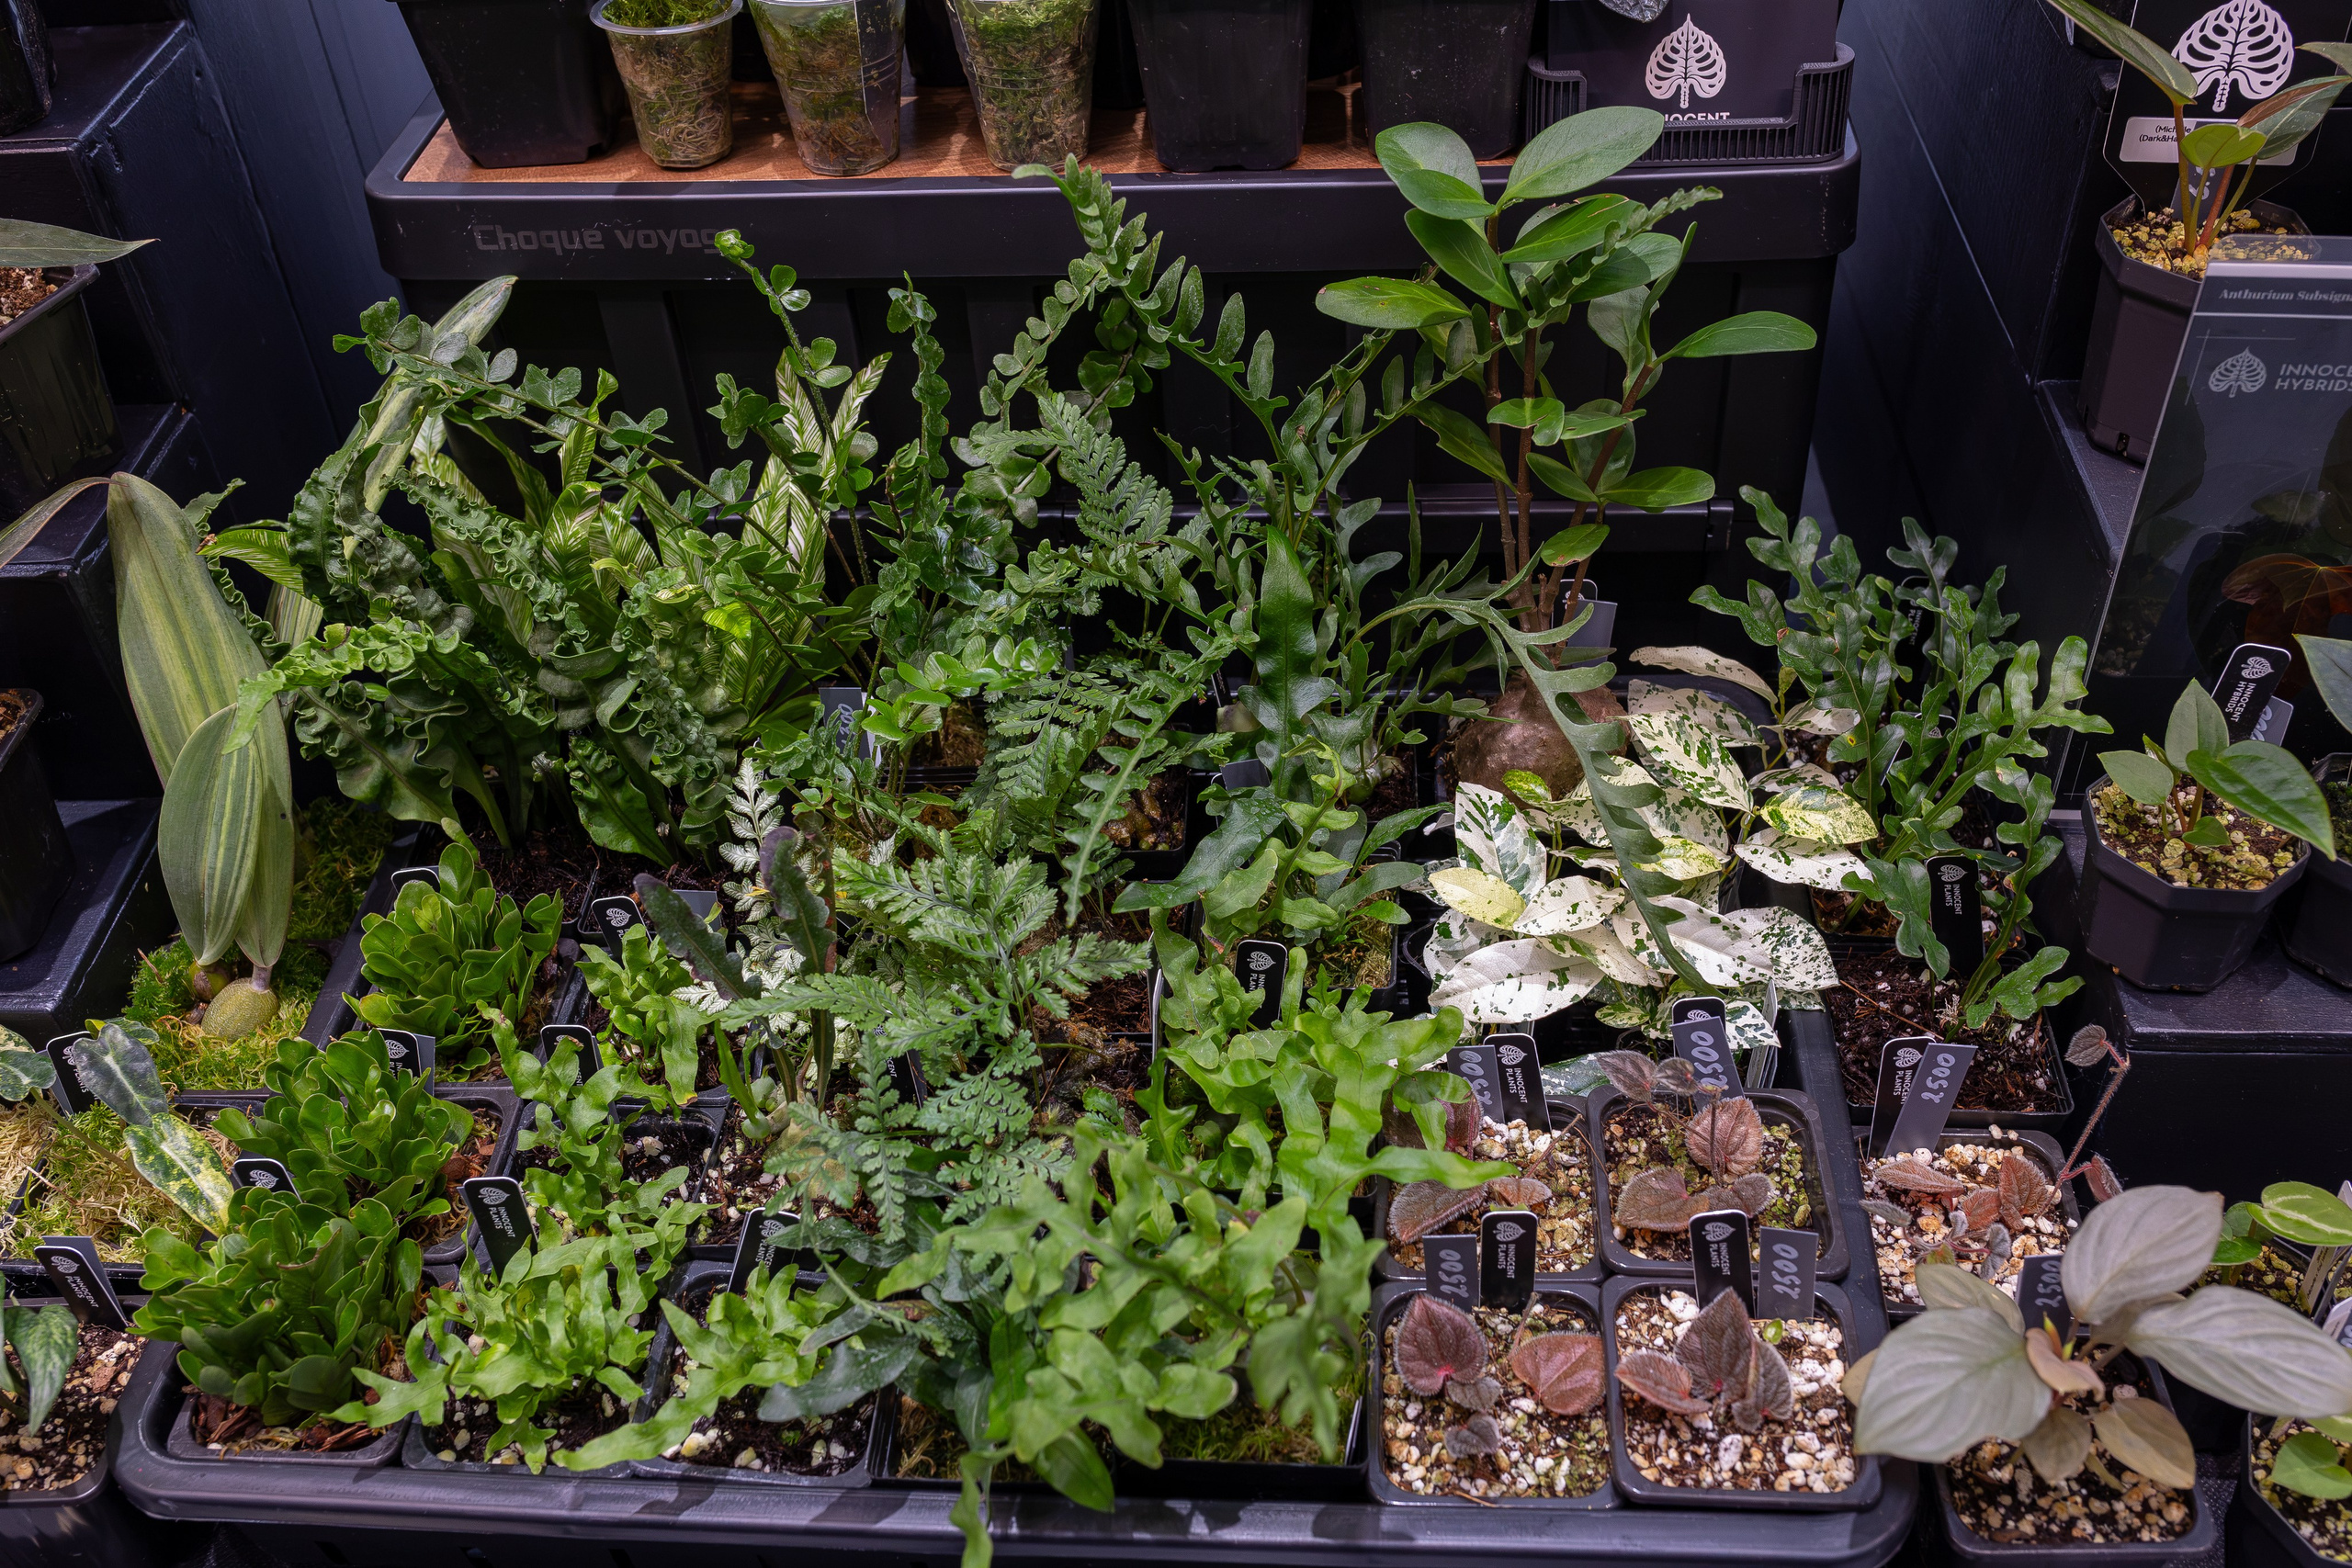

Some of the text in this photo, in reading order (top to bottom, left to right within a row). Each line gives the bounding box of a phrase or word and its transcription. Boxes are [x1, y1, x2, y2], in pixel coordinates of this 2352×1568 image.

[2139, 134, 2177, 142] (Dark&Ha
[473, 225, 720, 255] Choque voyag
[2219, 288, 2294, 300] Anthurium
[2224, 681, 2246, 713] HYBRIDS
[2230, 682, 2257, 723] INNOCENT
[1944, 884, 1953, 907] PLANTS
[1952, 884, 1962, 915] INNOCENT
[1690, 1031, 1729, 1090] 2500
[1506, 1067, 1517, 1094] PLANTS
[1514, 1067, 1528, 1103] INNOCENT
[1893, 1070, 1905, 1096] PLANTS
[1921, 1053, 1956, 1103] 2500
[488, 1206, 503, 1230] PLANTS
[497, 1206, 515, 1238] INNOCENT
[1498, 1244, 1507, 1269] PLANTS
[1506, 1244, 1516, 1279] INNOCENT
[1709, 1243, 1720, 1269] PLANTS
[1719, 1242, 1731, 1276] INNOCENT
[1770, 1243, 1802, 1300] 2500
[65, 1275, 85, 1299] PLANTS
[1438, 1248, 1470, 1298] 2500
[2034, 1259, 2063, 1308] 2500
[74, 1276, 99, 1308] INNOCENT
